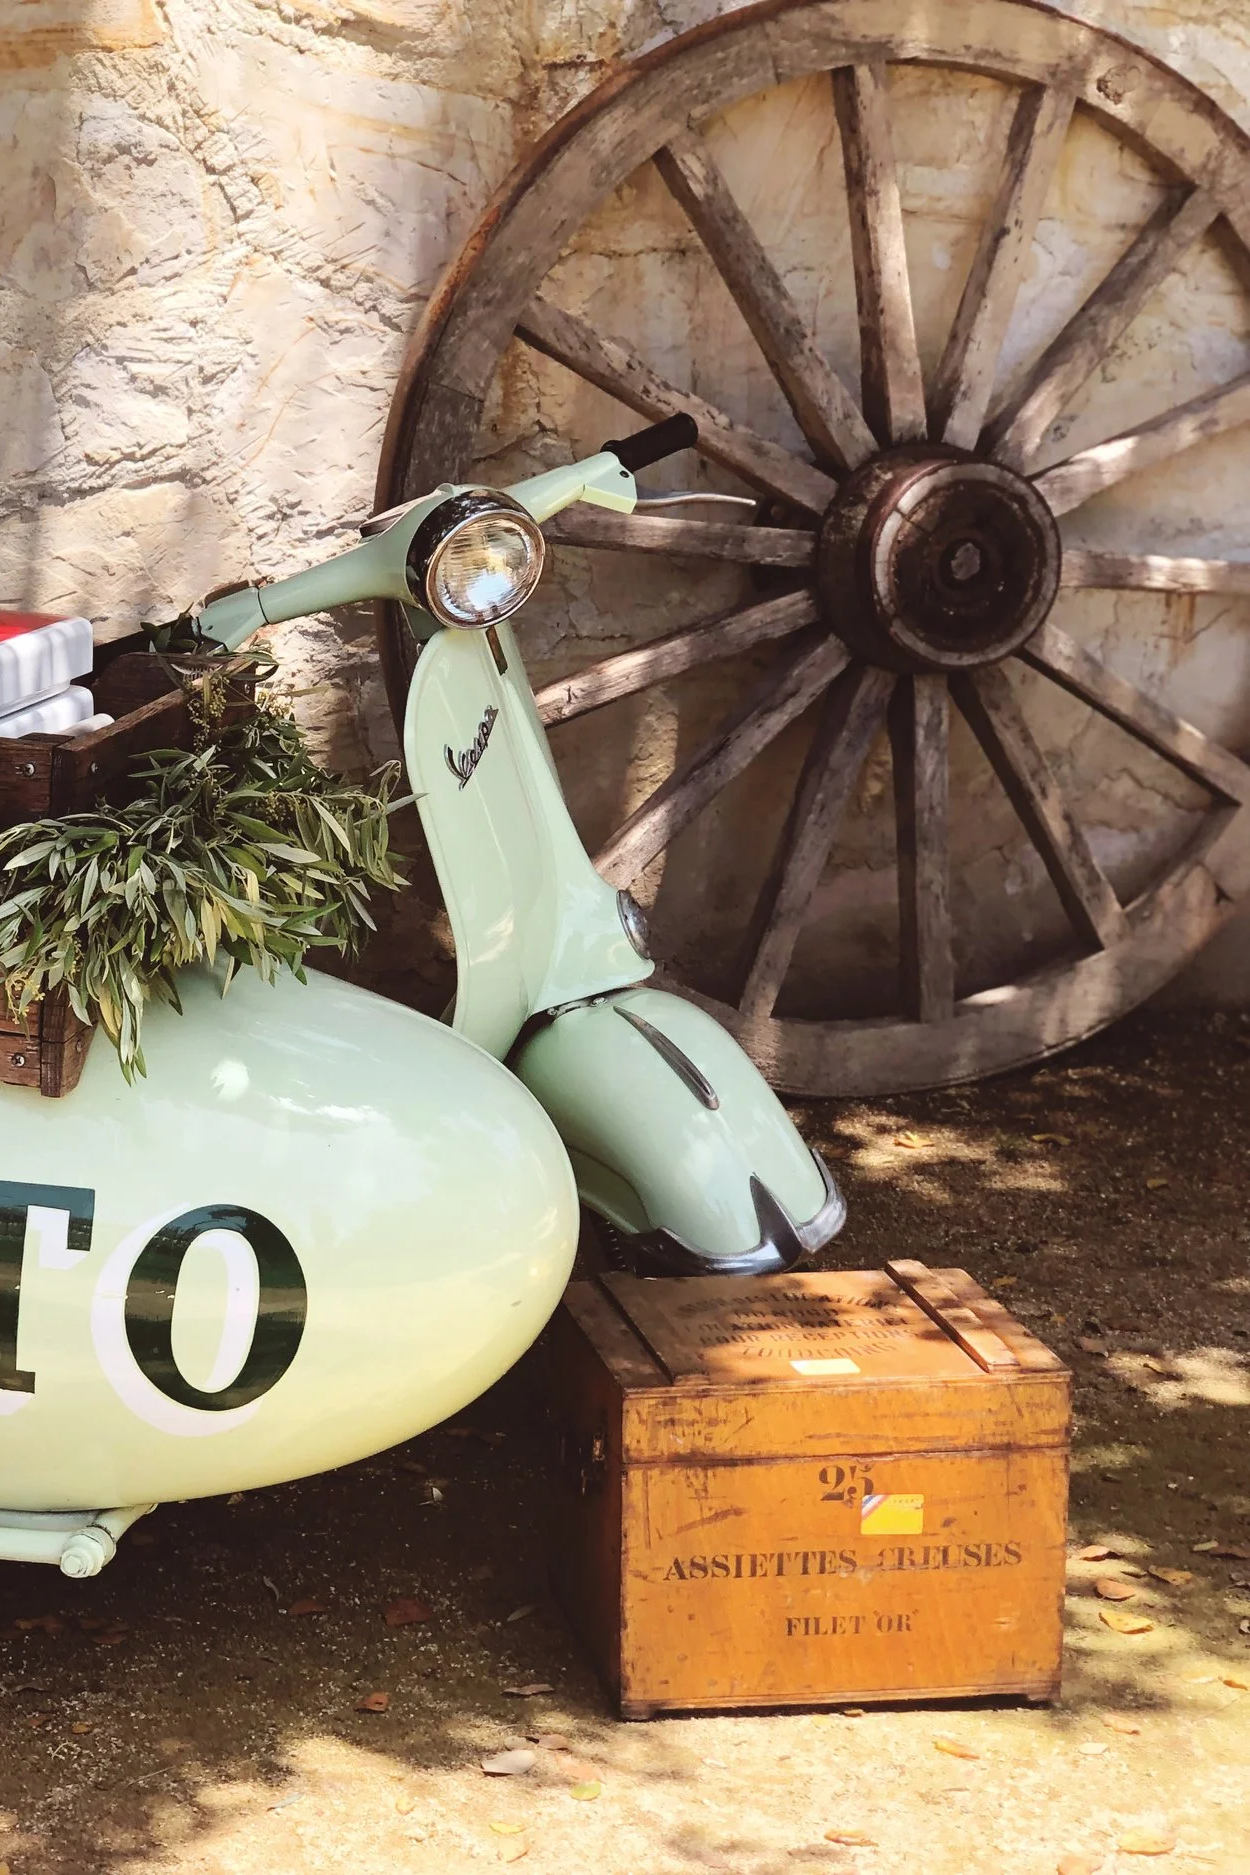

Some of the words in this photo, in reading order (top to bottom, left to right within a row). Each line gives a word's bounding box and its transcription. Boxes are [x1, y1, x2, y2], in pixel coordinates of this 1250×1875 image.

[443, 704, 499, 791] Vespa
[819, 1463, 874, 1508] 25
[663, 1549, 858, 1581] ASSIETTES
[877, 1541, 1023, 1571] CREUSES
[786, 1615, 866, 1636] FILET
